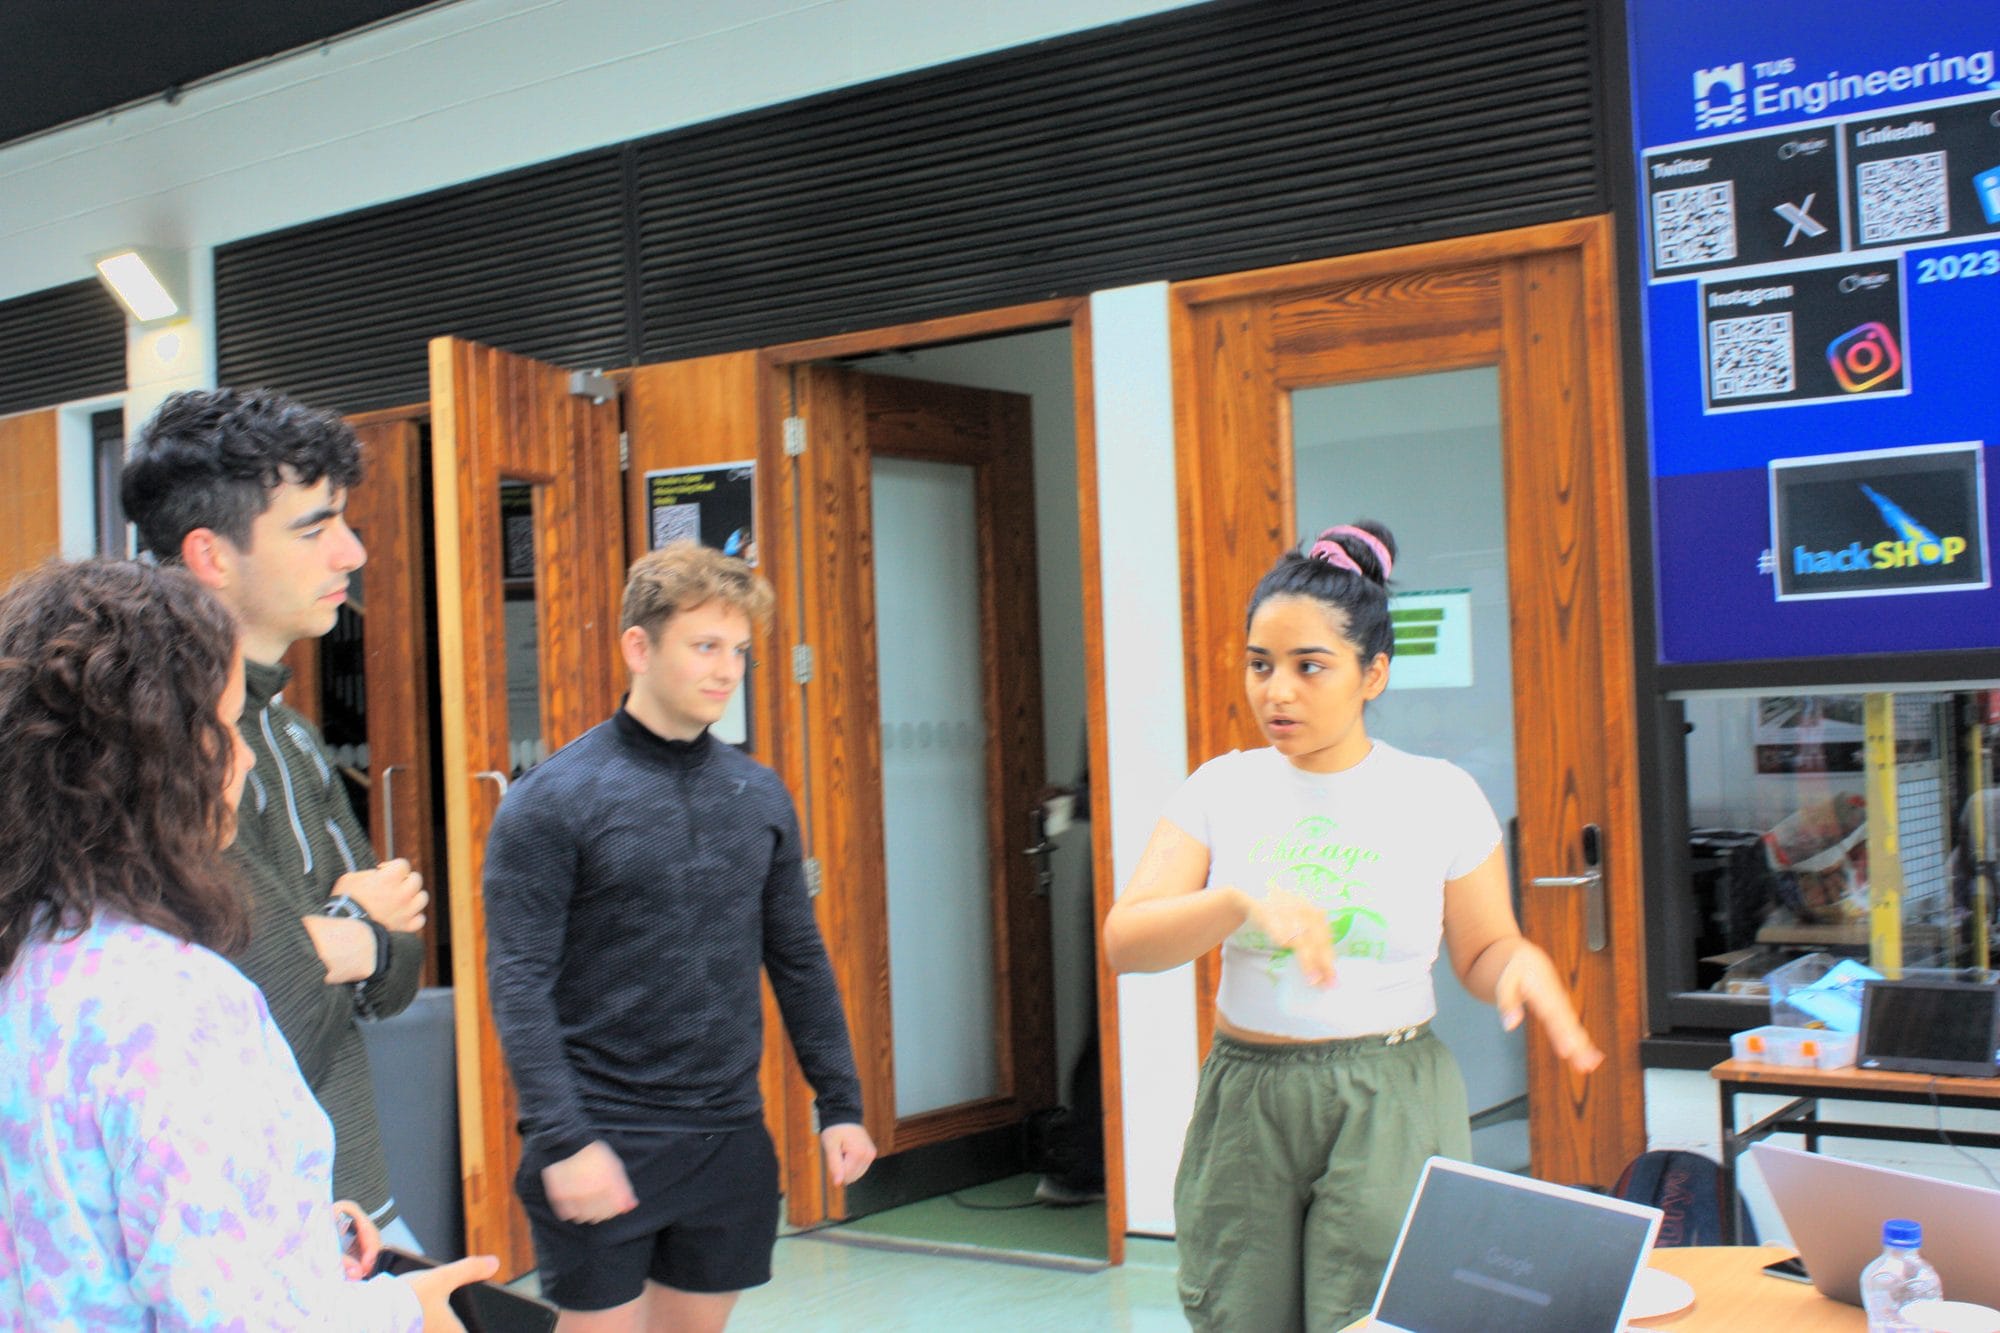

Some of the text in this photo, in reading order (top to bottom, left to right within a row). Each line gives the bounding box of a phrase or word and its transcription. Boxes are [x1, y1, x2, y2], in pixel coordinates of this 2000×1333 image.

[1752, 57, 1796, 79] TUS
[1753, 50, 1995, 116] Engineering
[1856, 121, 1936, 147] LinkedIn
[1650, 157, 1713, 179] Twitter
[1916, 249, 2000, 284] 2023
[1708, 285, 1794, 307] Instagram
[1248, 831, 1383, 873] Chicago
